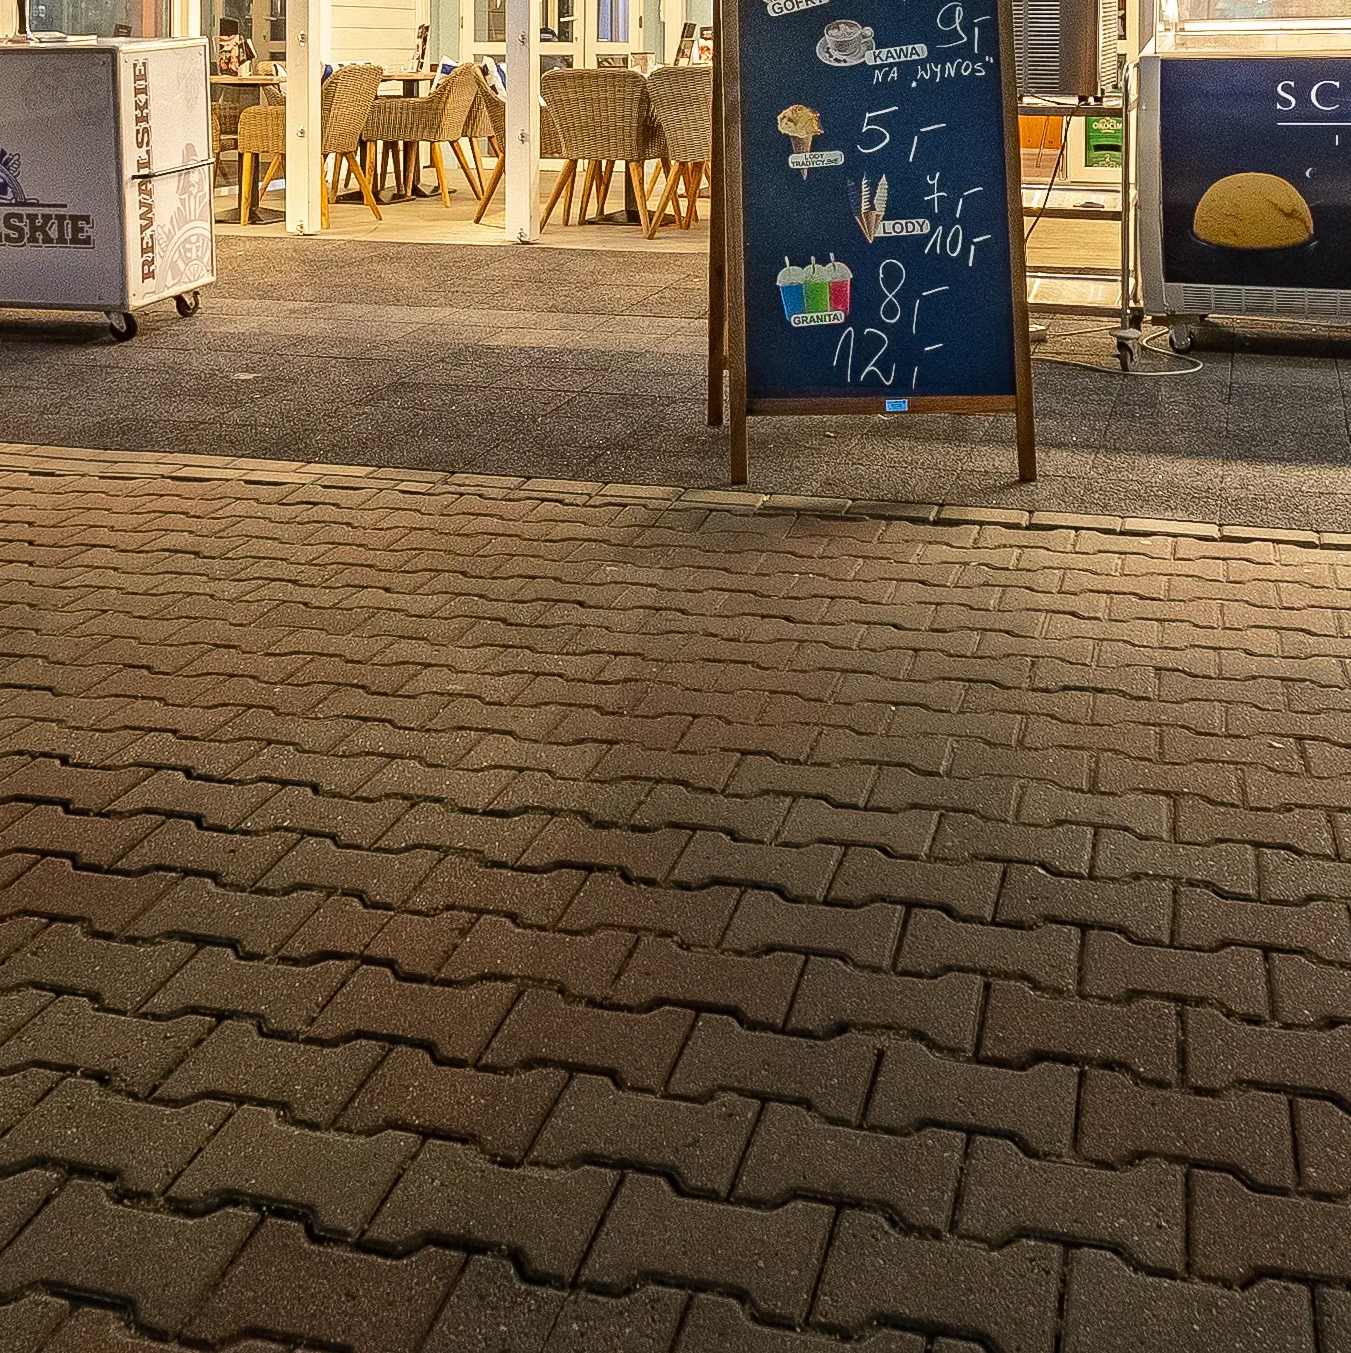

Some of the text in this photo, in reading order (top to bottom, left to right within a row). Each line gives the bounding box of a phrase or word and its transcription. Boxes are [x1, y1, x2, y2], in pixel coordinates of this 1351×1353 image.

[872, 46, 921, 63] KAWA
[873, 66, 899, 84] NA
[133, 58, 157, 284] REWALSKIE
[882, 220, 925, 235] LODY
[793, 313, 840, 326] GRANITA
